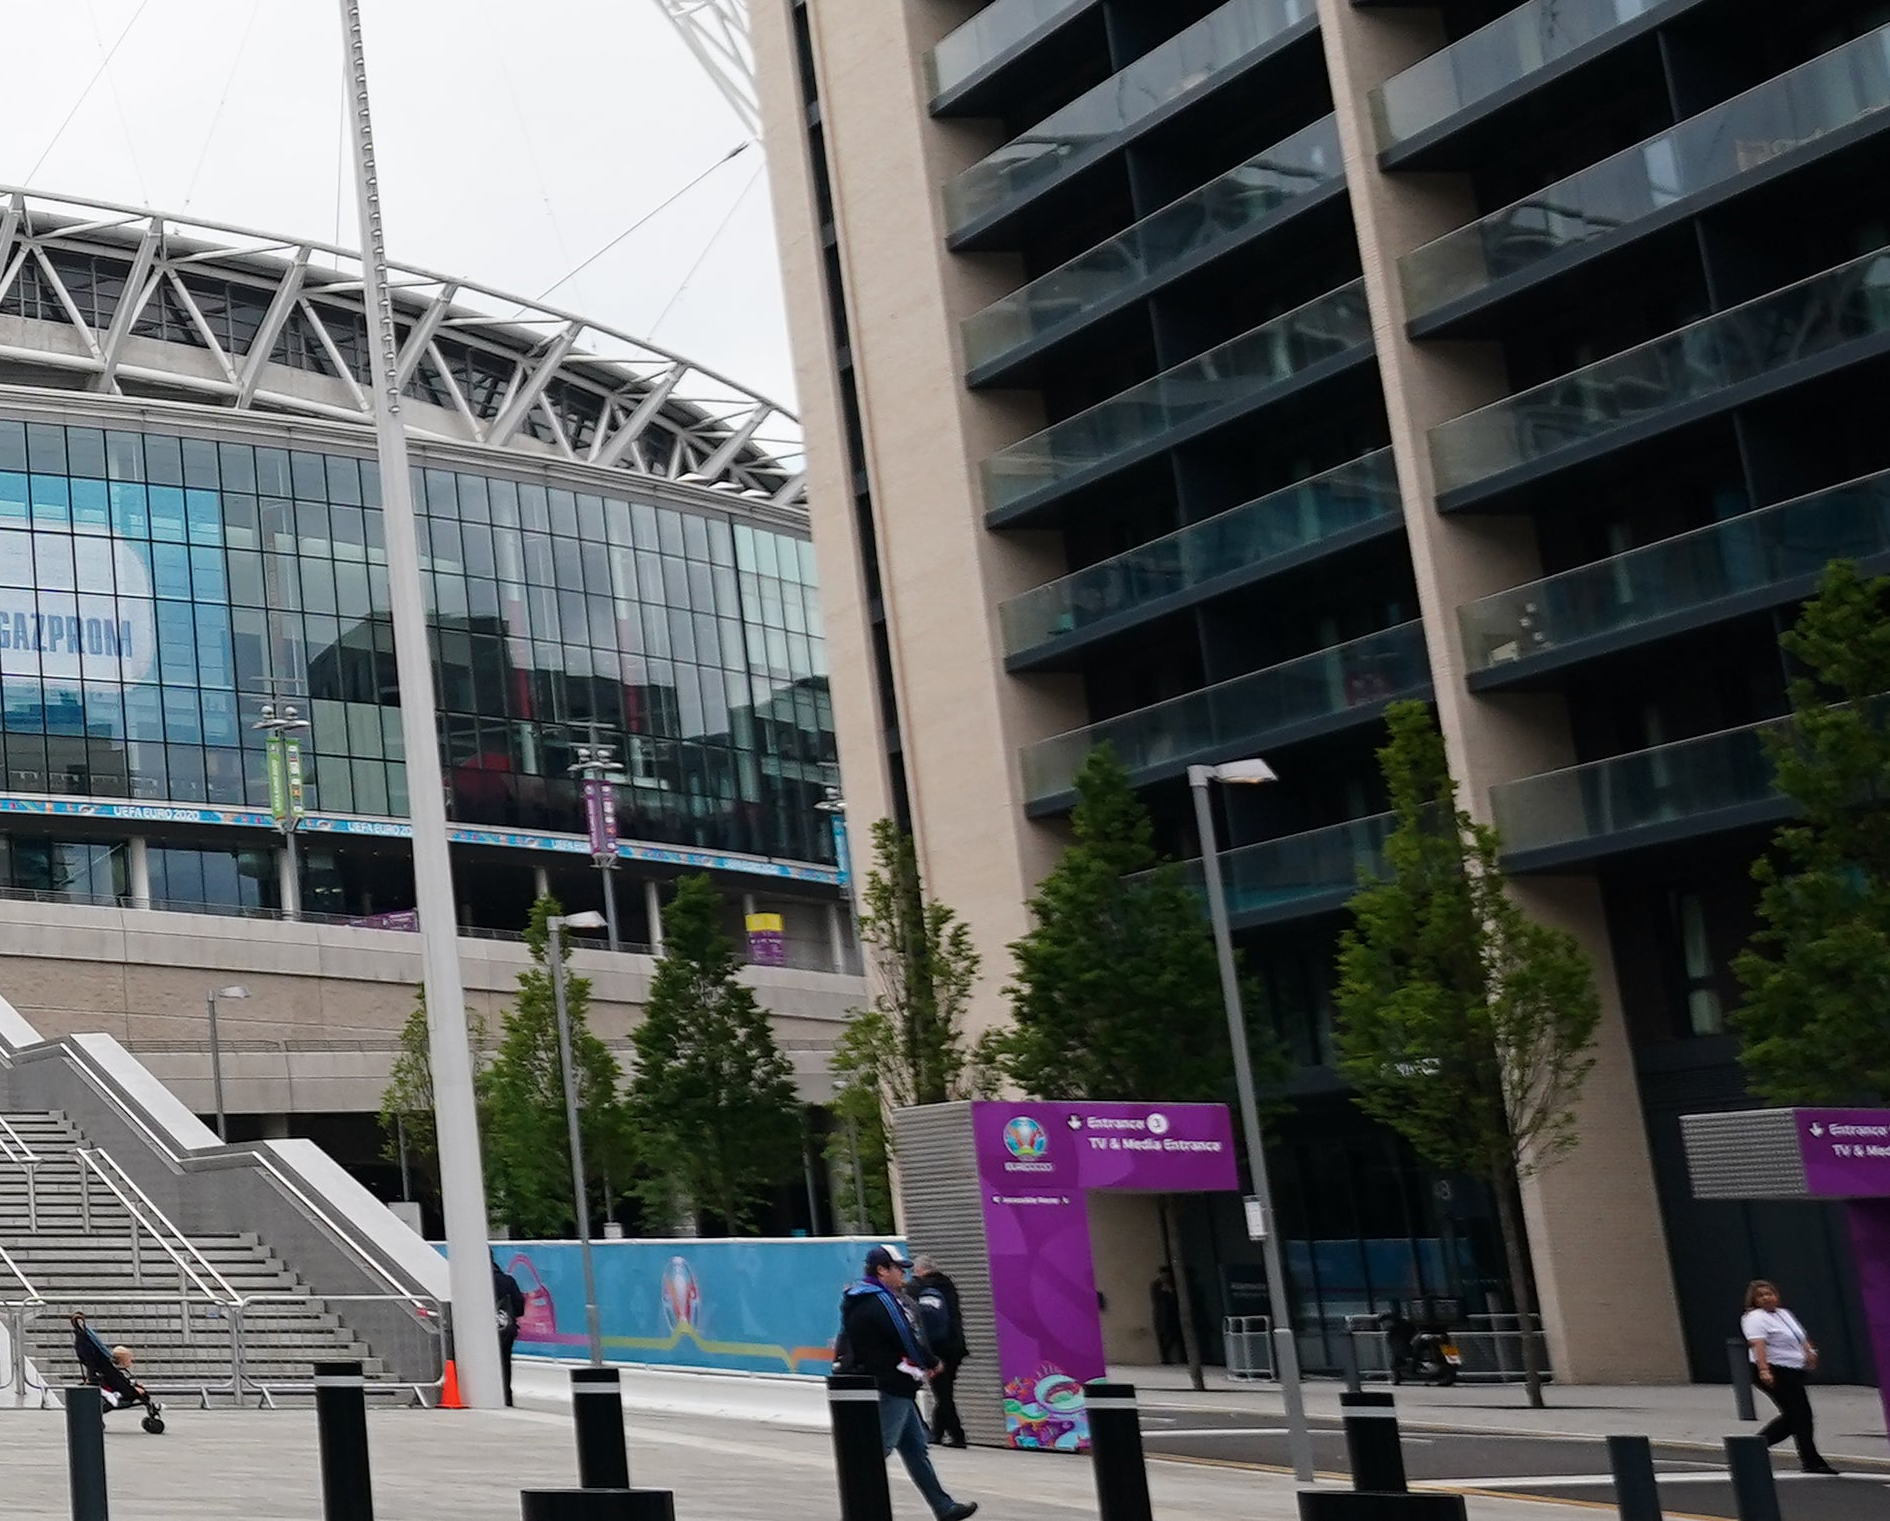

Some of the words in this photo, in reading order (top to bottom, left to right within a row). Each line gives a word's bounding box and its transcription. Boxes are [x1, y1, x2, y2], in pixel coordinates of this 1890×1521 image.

[113, 806, 143, 817] UEFA
[143, 807, 172, 819] EURO
[173, 809, 200, 820] 2020
[1087, 1117, 1145, 1129] Entrance
[1828, 1123, 1889, 1137] Entrance
[1088, 1137, 1106, 1149] TV
[1109, 1138, 1120, 1149] &
[1122, 1139, 1162, 1151] Media
[1163, 1139, 1221, 1152] Entrance
[1831, 1144, 1852, 1158] TV
